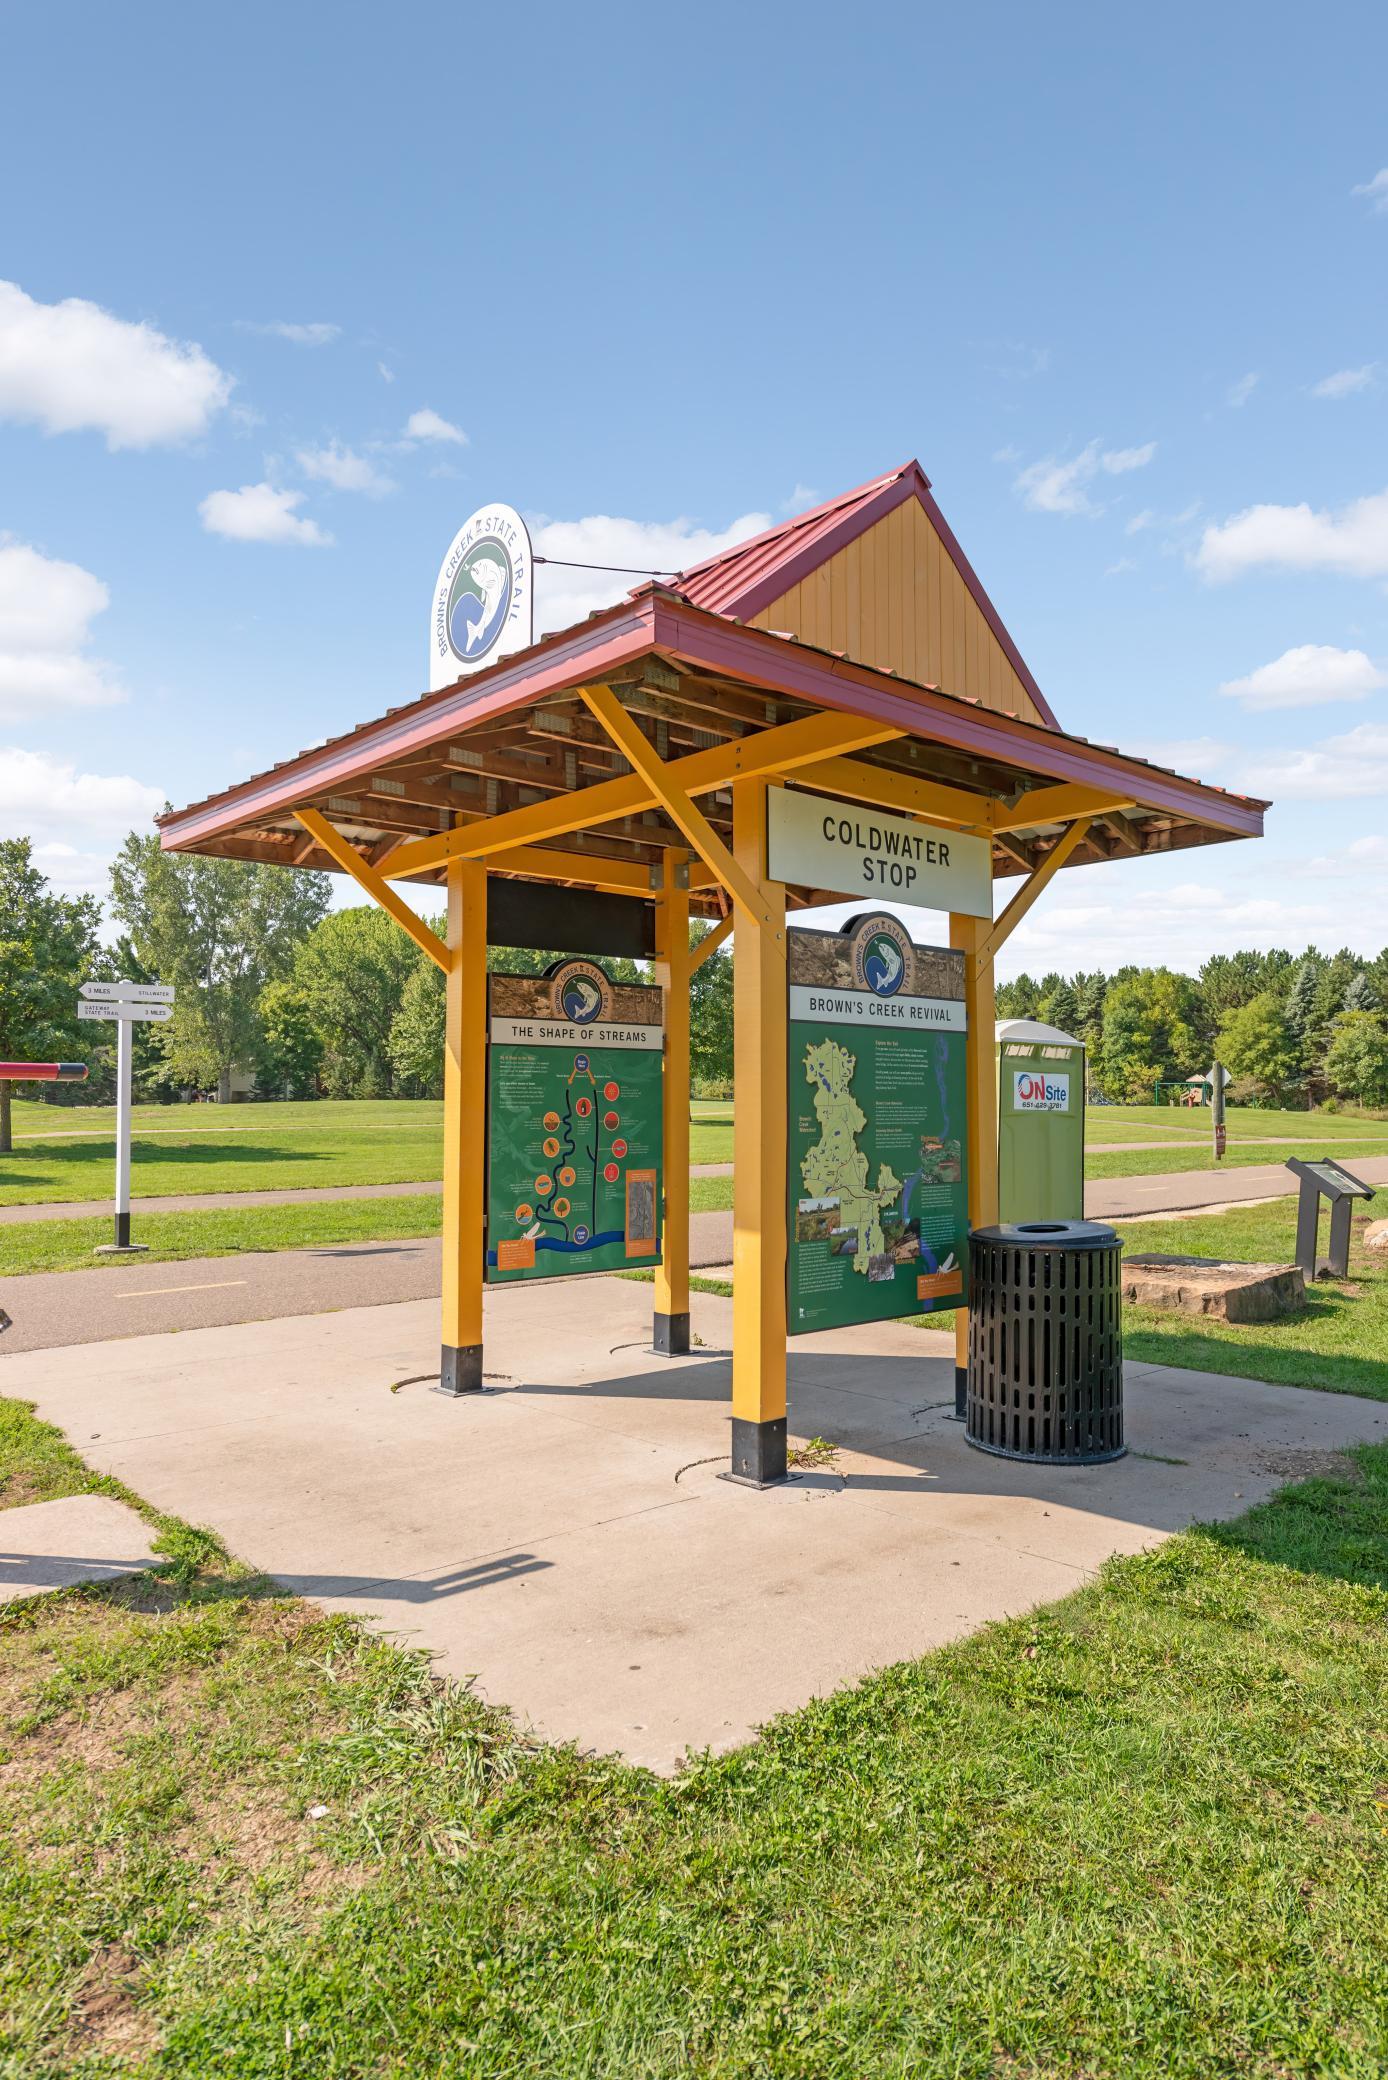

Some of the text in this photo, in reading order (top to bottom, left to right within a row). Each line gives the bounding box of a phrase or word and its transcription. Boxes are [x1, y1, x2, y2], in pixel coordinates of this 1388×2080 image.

[436, 517, 524, 657] BROWN'S CREEK STATE TRAIL
[822, 816, 950, 867] COLDWATER
[863, 857, 917, 889] STOP
[861, 922, 880, 942] CREEK
[887, 924, 907, 950] STATE
[902, 956, 912, 989] TRAIL
[809, 997, 952, 1022] BROWN'S CREEK REVIVAL
[511, 1026, 647, 1042] THE SHAPE OF STREAMS
